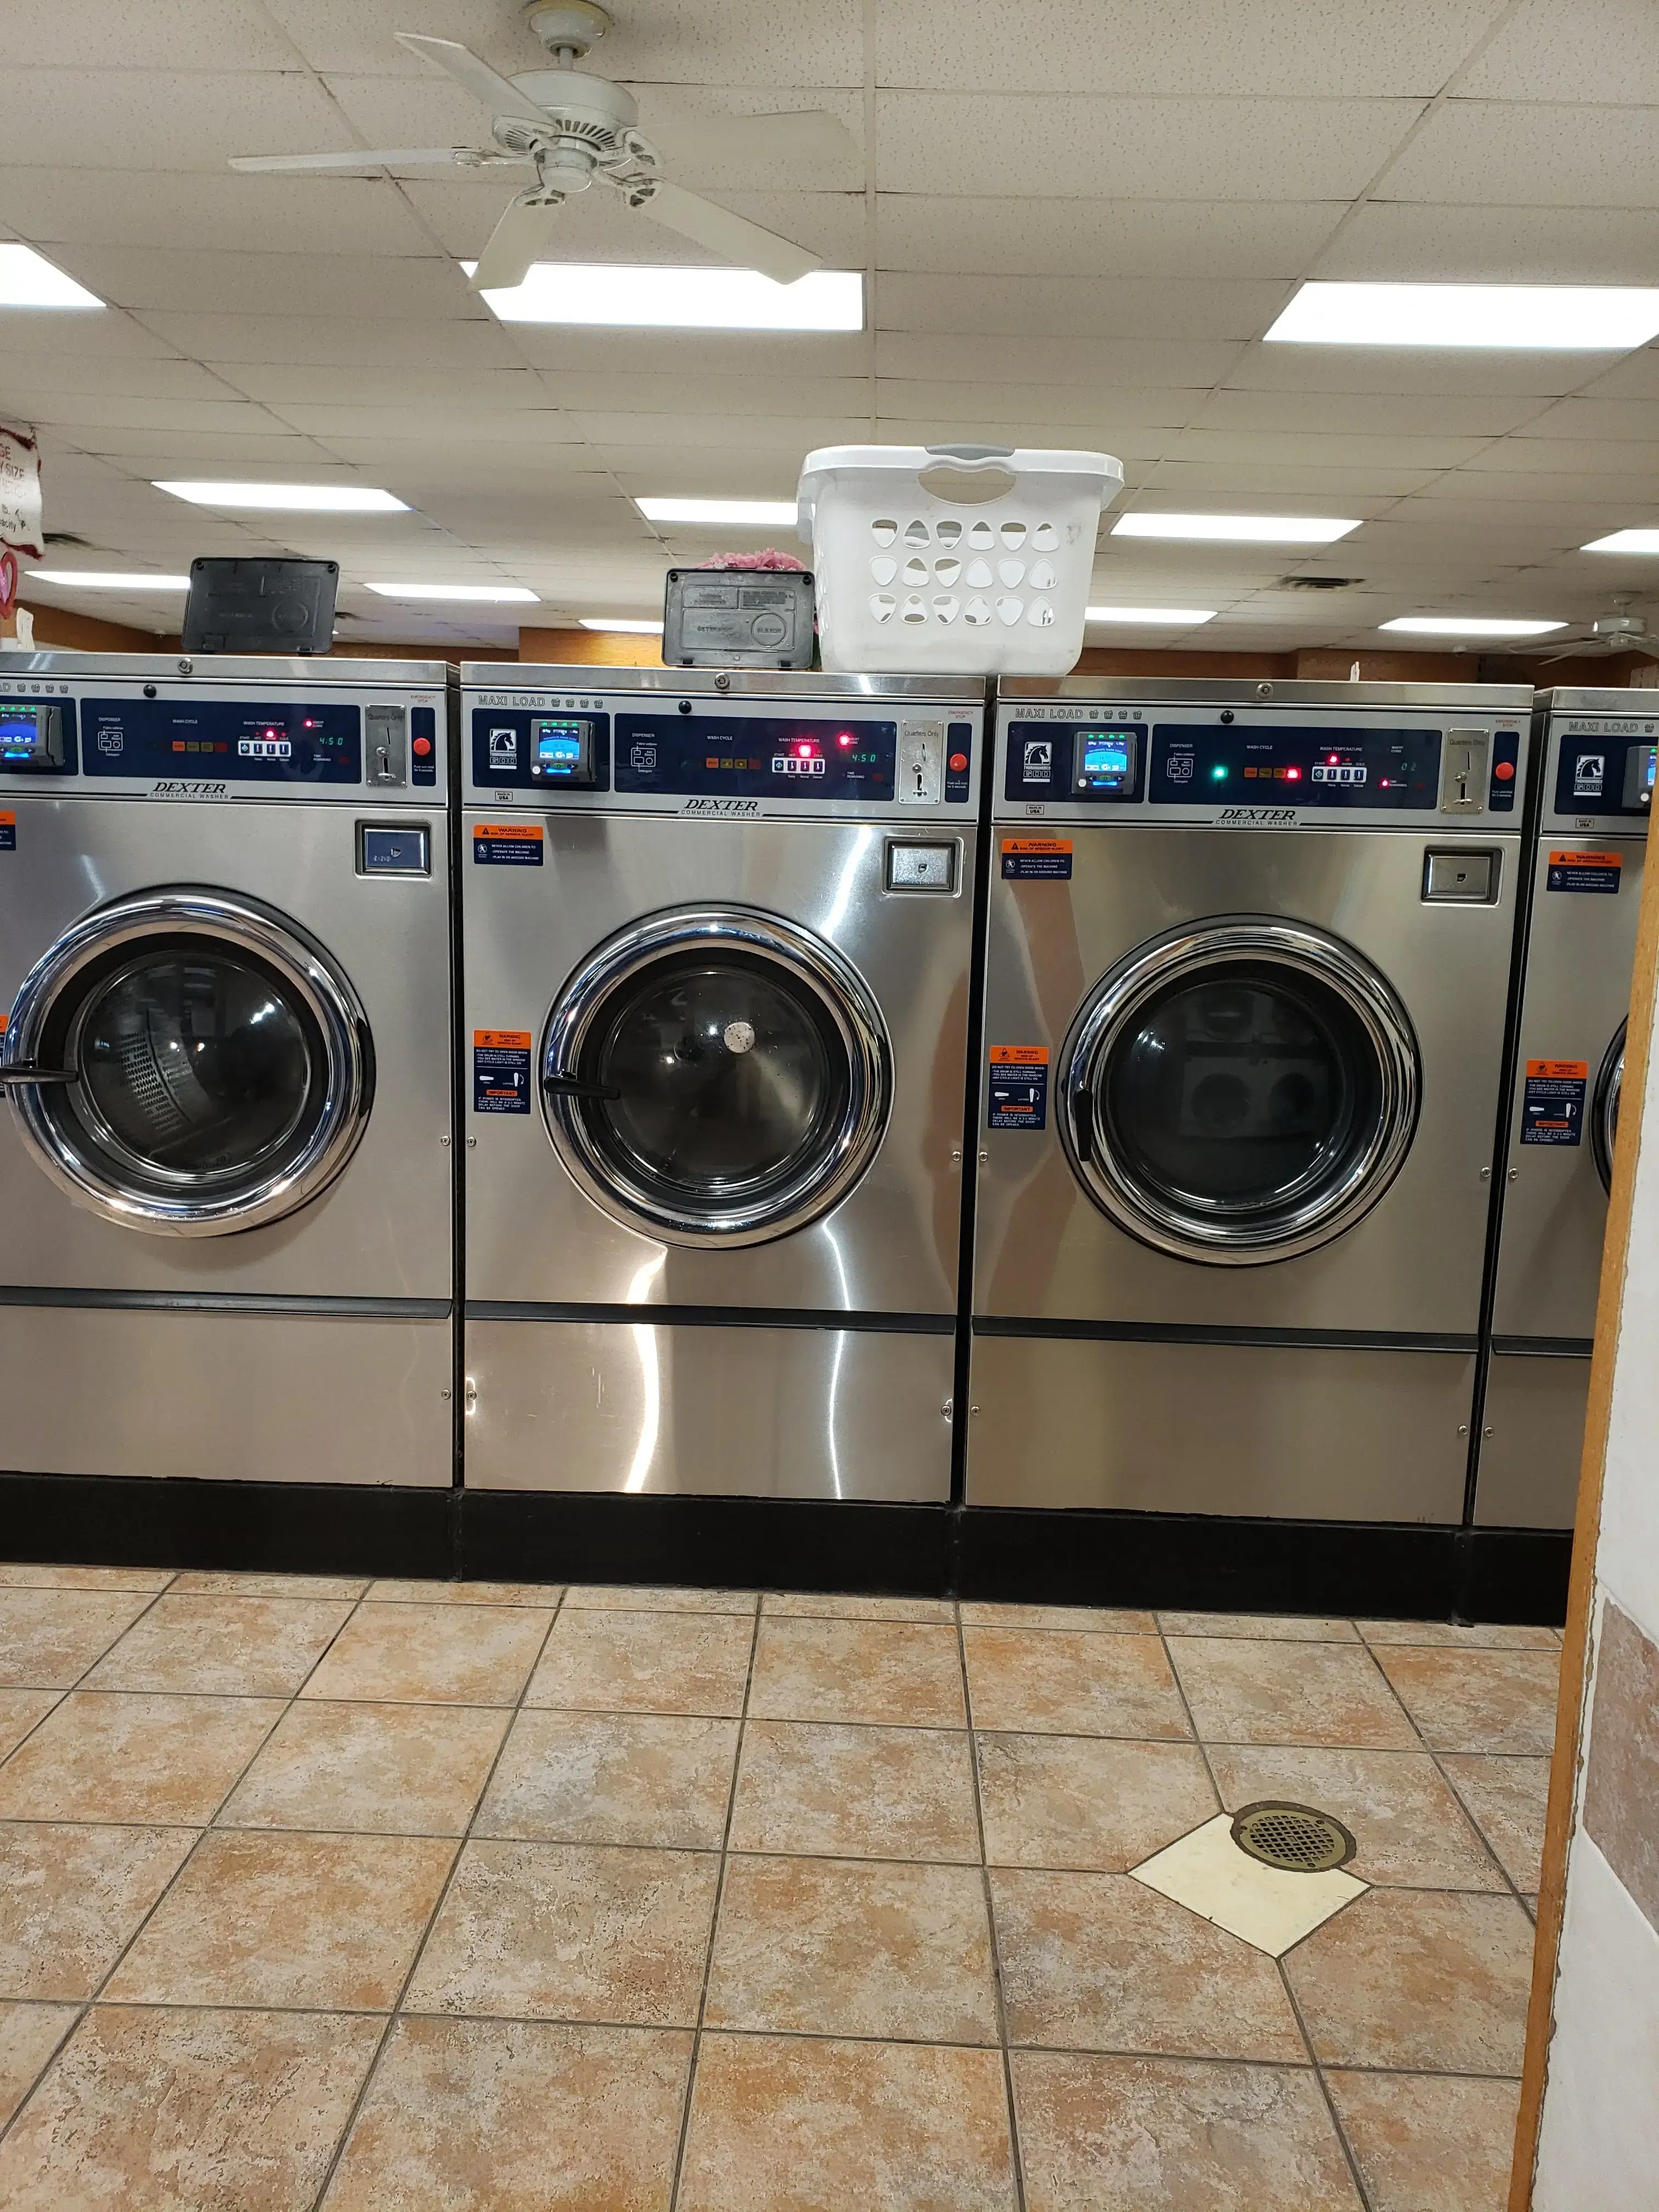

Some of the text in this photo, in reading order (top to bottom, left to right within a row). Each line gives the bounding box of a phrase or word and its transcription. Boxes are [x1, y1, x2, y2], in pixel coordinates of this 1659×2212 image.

[478, 695, 545, 707] MAXI LOAD
[1015, 708, 1083, 719] MAXI LOAD
[1568, 721, 1638, 732] MAXI LOAD
[852, 754, 876, 763] 4.50
[153, 782, 226, 793] DEXTER
[684, 799, 758, 811] DEXTER
[1218, 809, 1296, 820] DEXTER
